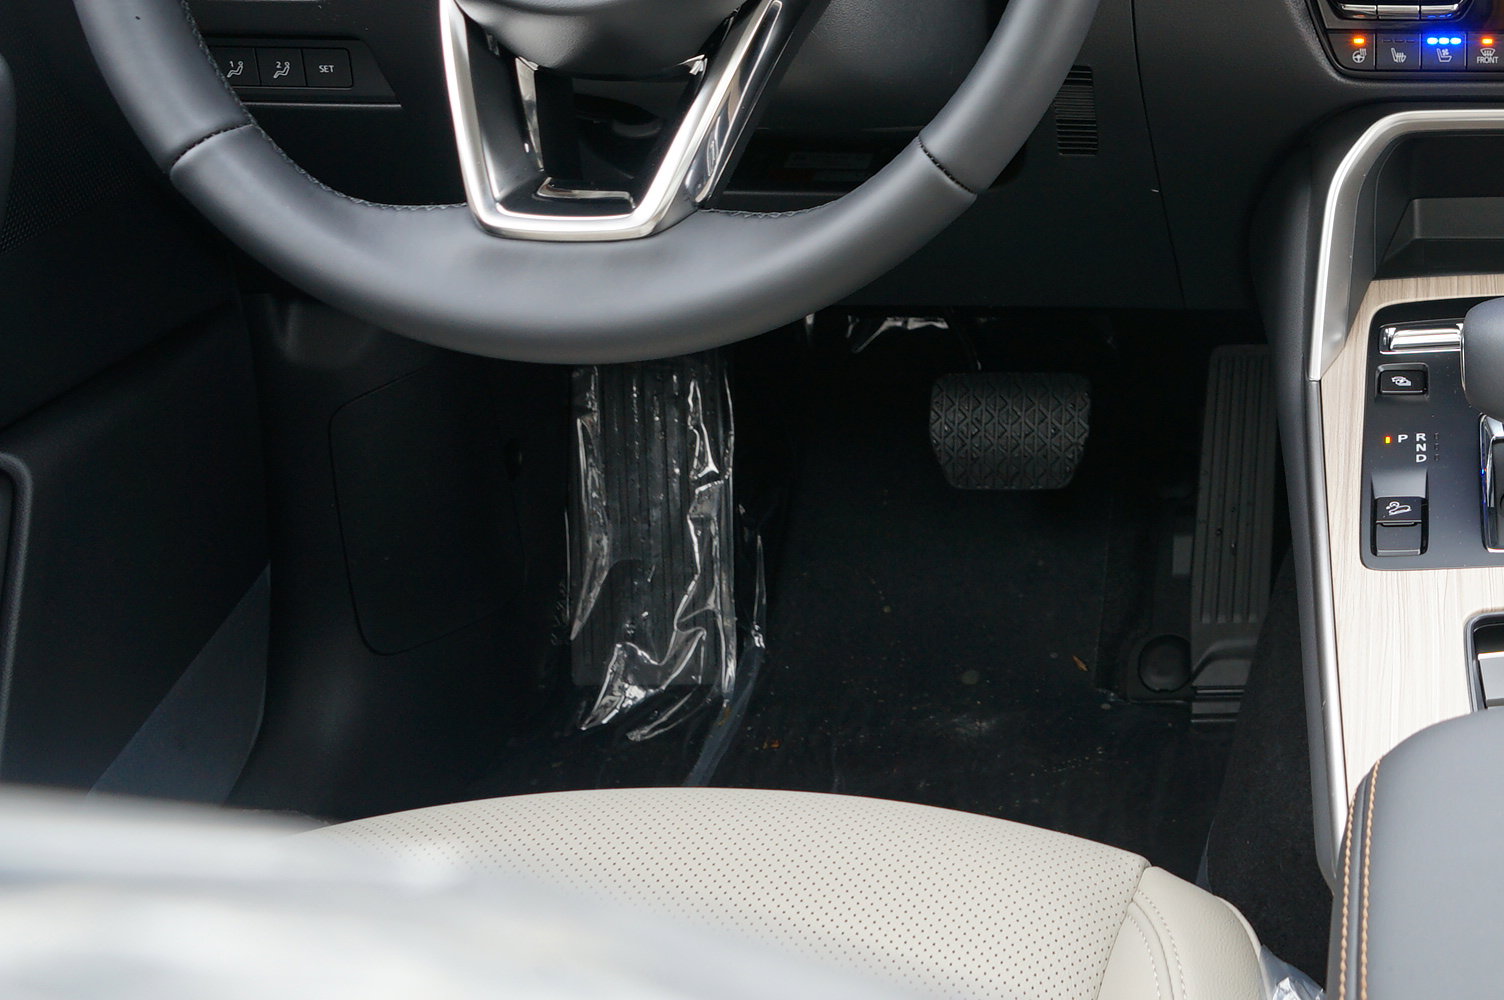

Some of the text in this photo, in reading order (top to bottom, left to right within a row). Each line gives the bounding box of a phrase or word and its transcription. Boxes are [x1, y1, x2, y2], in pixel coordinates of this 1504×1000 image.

[276, 61, 282, 69] 2
[1476, 55, 1499, 65] FRONT
[319, 64, 335, 73] SET
[1397, 433, 1408, 443] P
[1416, 432, 1426, 442] R
[1416, 443, 1427, 452] N
[1416, 453, 1427, 463] D
